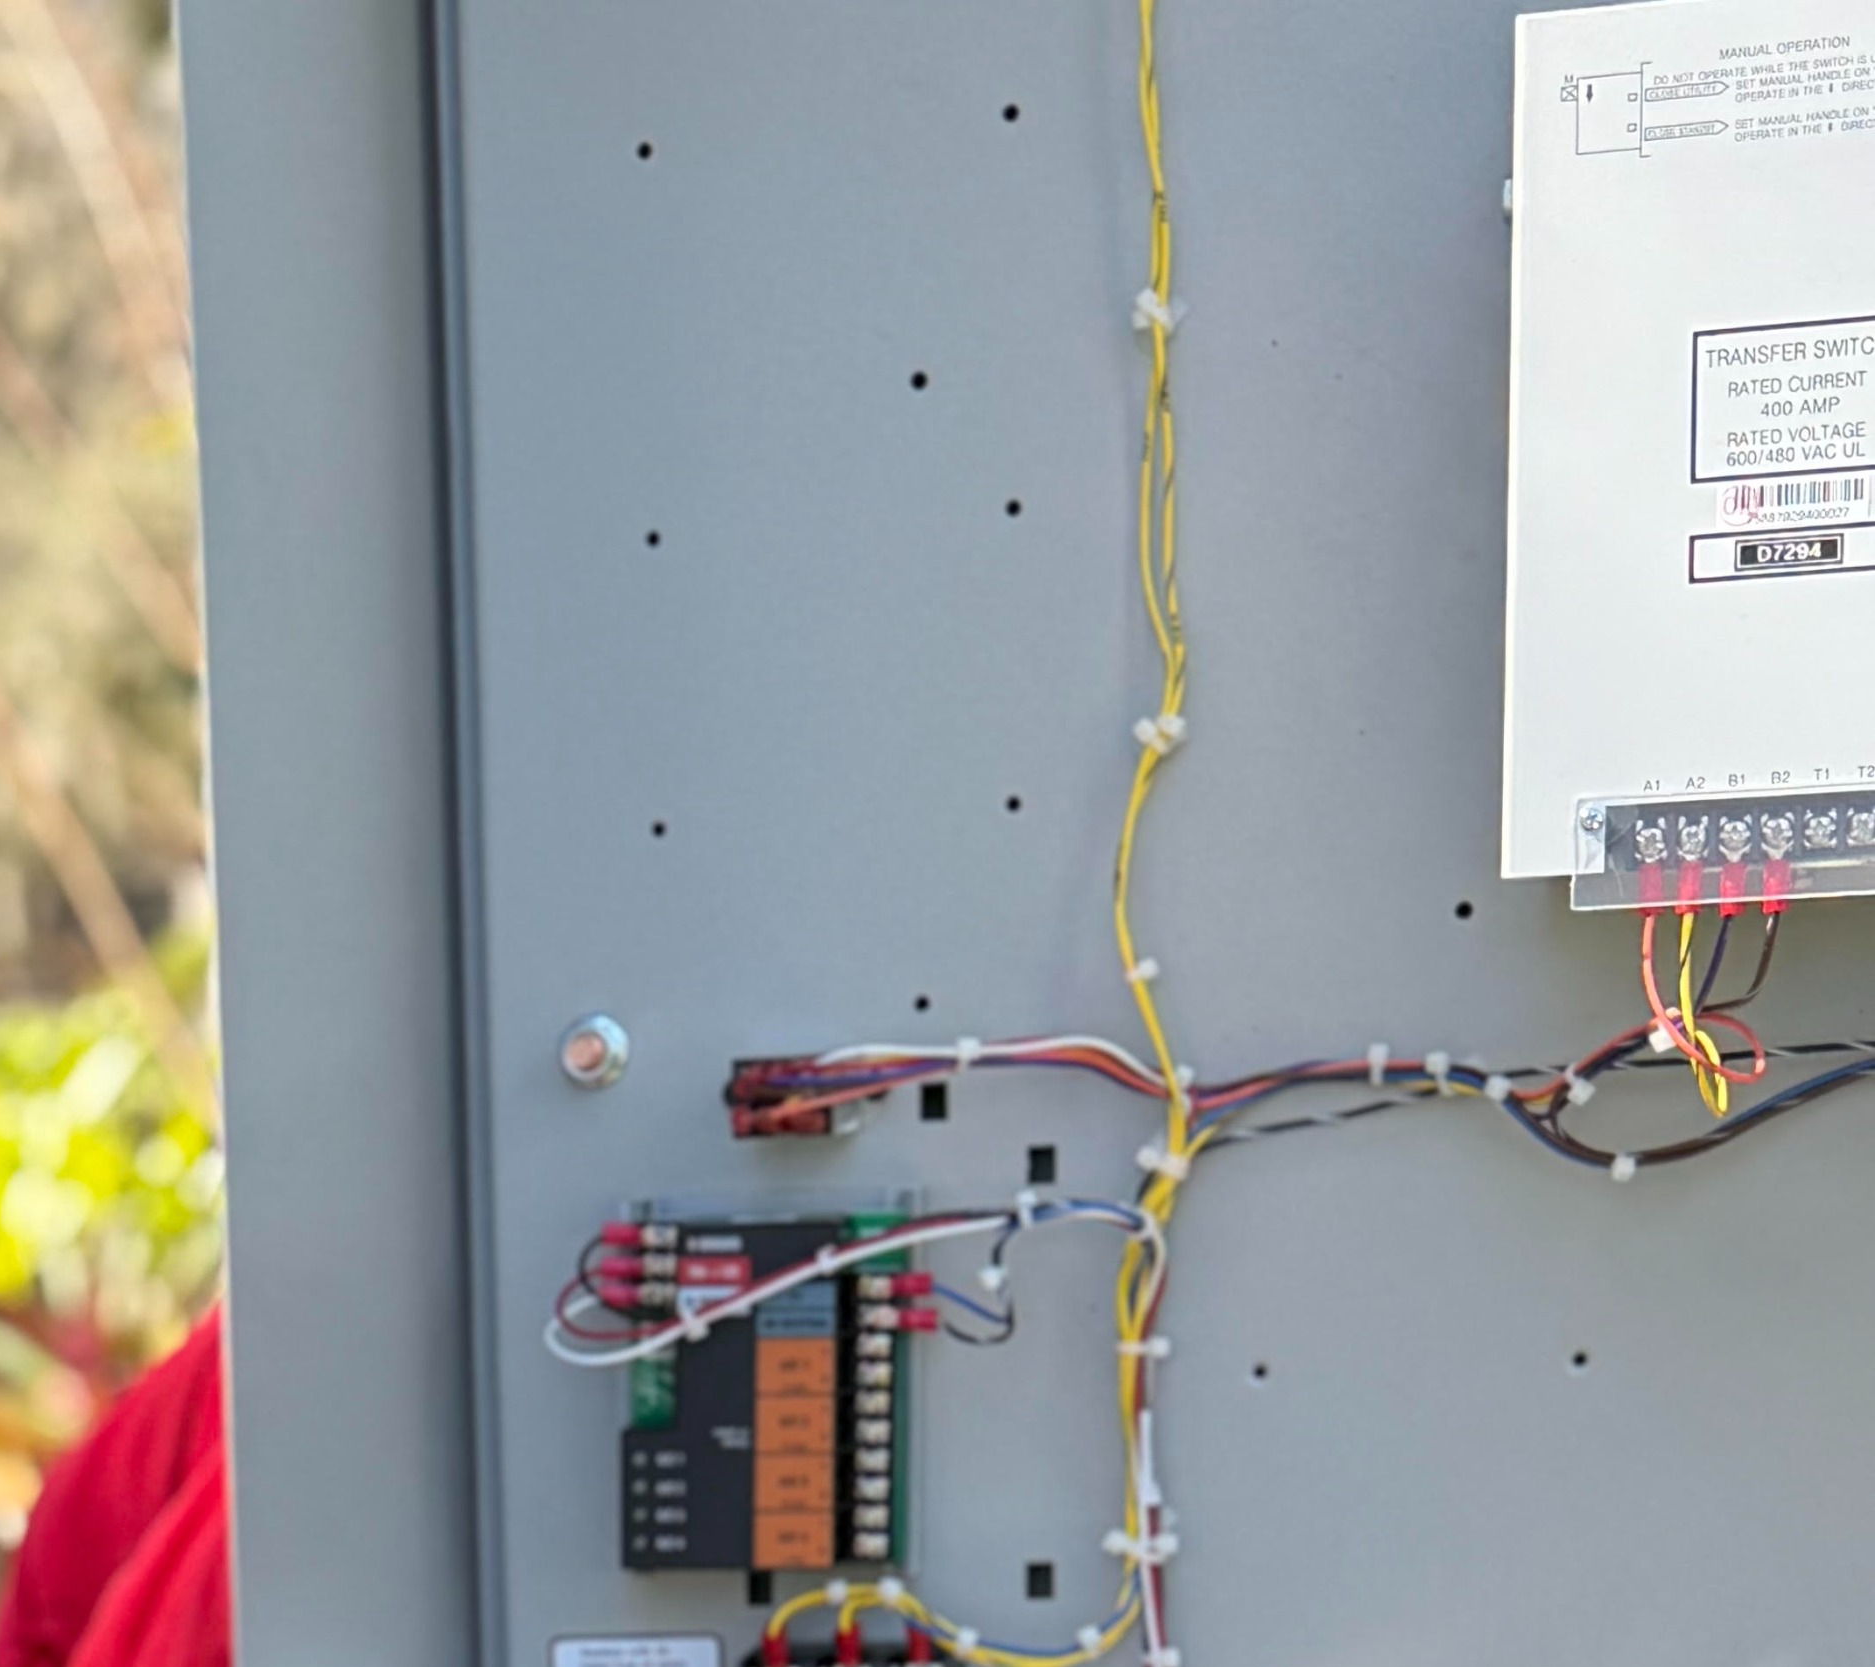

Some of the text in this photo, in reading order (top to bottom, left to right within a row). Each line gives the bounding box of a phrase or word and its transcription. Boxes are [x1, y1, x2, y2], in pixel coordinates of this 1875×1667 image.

[1719, 36, 1850, 60] MANUAL OPERATION
[1653, 75, 1669, 85] DO
[1673, 72, 1694, 83] NOT
[1698, 66, 1747, 81] OPERATE
[1751, 63, 1784, 75] WHILE
[1789, 60, 1809, 71] THE
[1813, 56, 1854, 69] SWITCH
[1857, 55, 1867, 64] IS
[1736, 78, 1756, 90] SET
[1759, 74, 1804, 86] MANUAL
[1808, 68, 1851, 82] HANDLE
[1735, 88, 1785, 103] OPERATE
[1788, 87, 1799, 98] IN
[1804, 84, 1823, 95] THE
[1735, 118, 1754, 130] SET
[1758, 113, 1803, 125] MANUAL
[1806, 108, 1849, 121] HANDLE
[1734, 127, 1784, 142] OPERATE
[1787, 127, 1798, 137] IN
[1803, 123, 1822, 134] THE
[1705, 341, 1806, 368] TRANSFER
[1728, 370, 1867, 398] RATED CURRENT
[1761, 396, 1841, 417] 400 AMP
[1727, 421, 1866, 448] RATED VOLTAGE
[1726, 442, 1866, 467] 600/480 VAC UL
[1757, 542, 1822, 562] D7294
[1643, 765, 1875, 791] A1 A2 B1 B2 T1 T2
